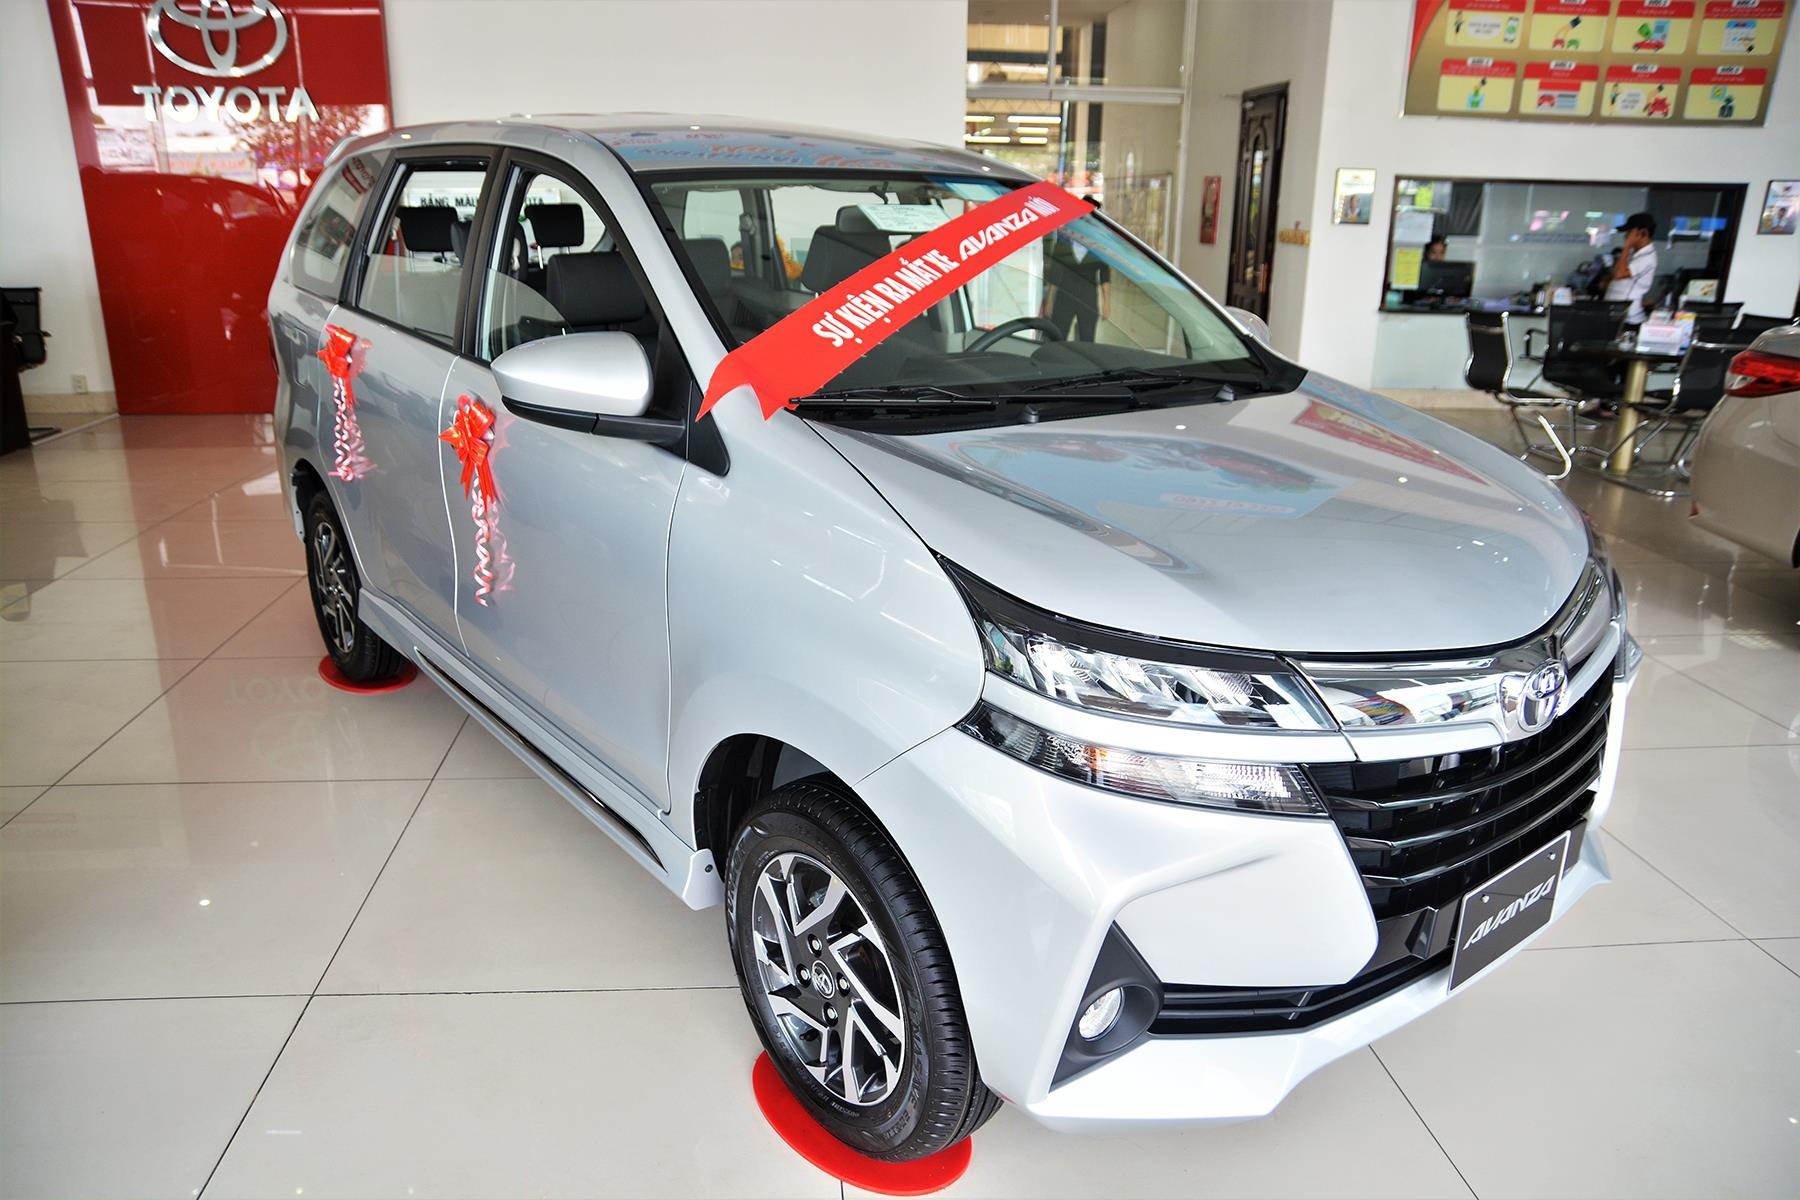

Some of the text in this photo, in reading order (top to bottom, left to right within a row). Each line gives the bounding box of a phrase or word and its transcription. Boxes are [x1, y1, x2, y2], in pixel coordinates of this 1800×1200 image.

[131, 85, 320, 123] TOYOTA
[959, 207, 1039, 261] AVANZA
[894, 257, 943, 291] MẮT
[922, 249, 960, 273] XE
[873, 277, 916, 304] RA
[835, 289, 895, 330] KIỆN
[812, 312, 863, 347] SỰ
[1463, 874, 1556, 951] AVANZA
